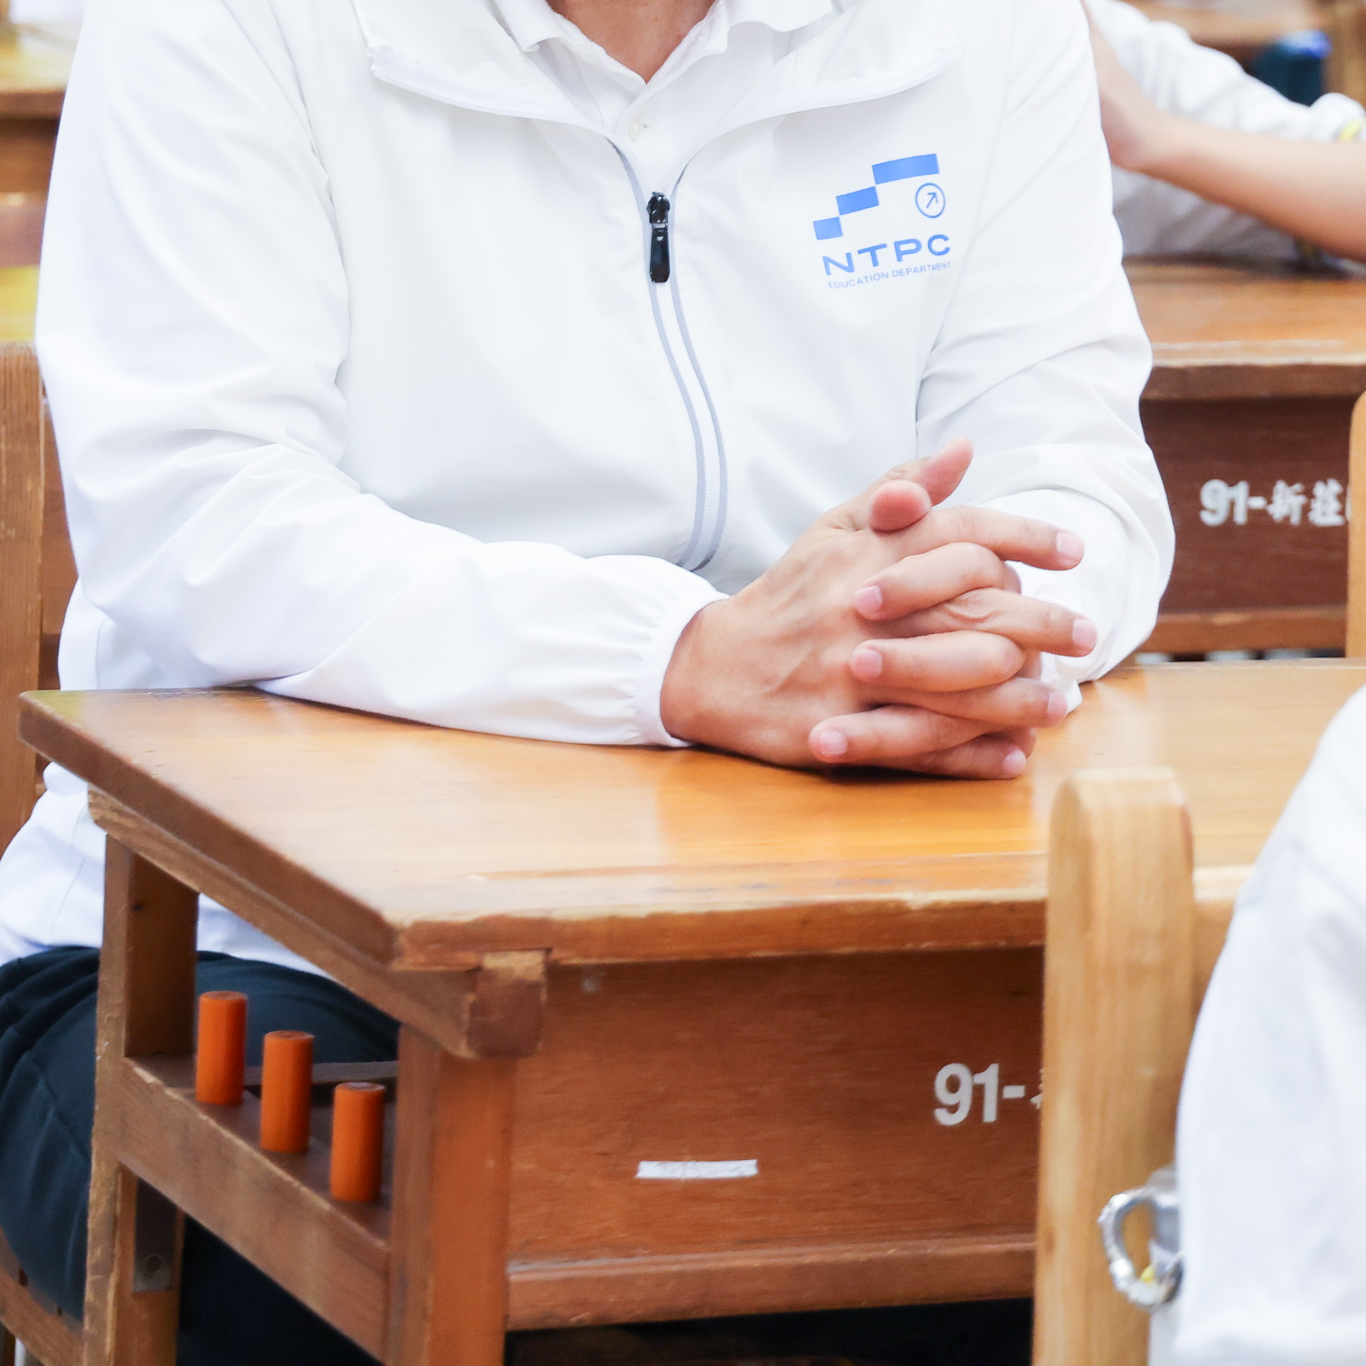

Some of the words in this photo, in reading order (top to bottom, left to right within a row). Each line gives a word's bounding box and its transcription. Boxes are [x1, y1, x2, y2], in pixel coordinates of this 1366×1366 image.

[822, 234, 951, 275] NTPC
[828, 271, 890, 290] EDUCATION
[891, 260, 952, 279] DEPARTMENT
[1199, 477, 1351, 527] 91-新莊
[932, 1061, 1043, 1127] 91-
